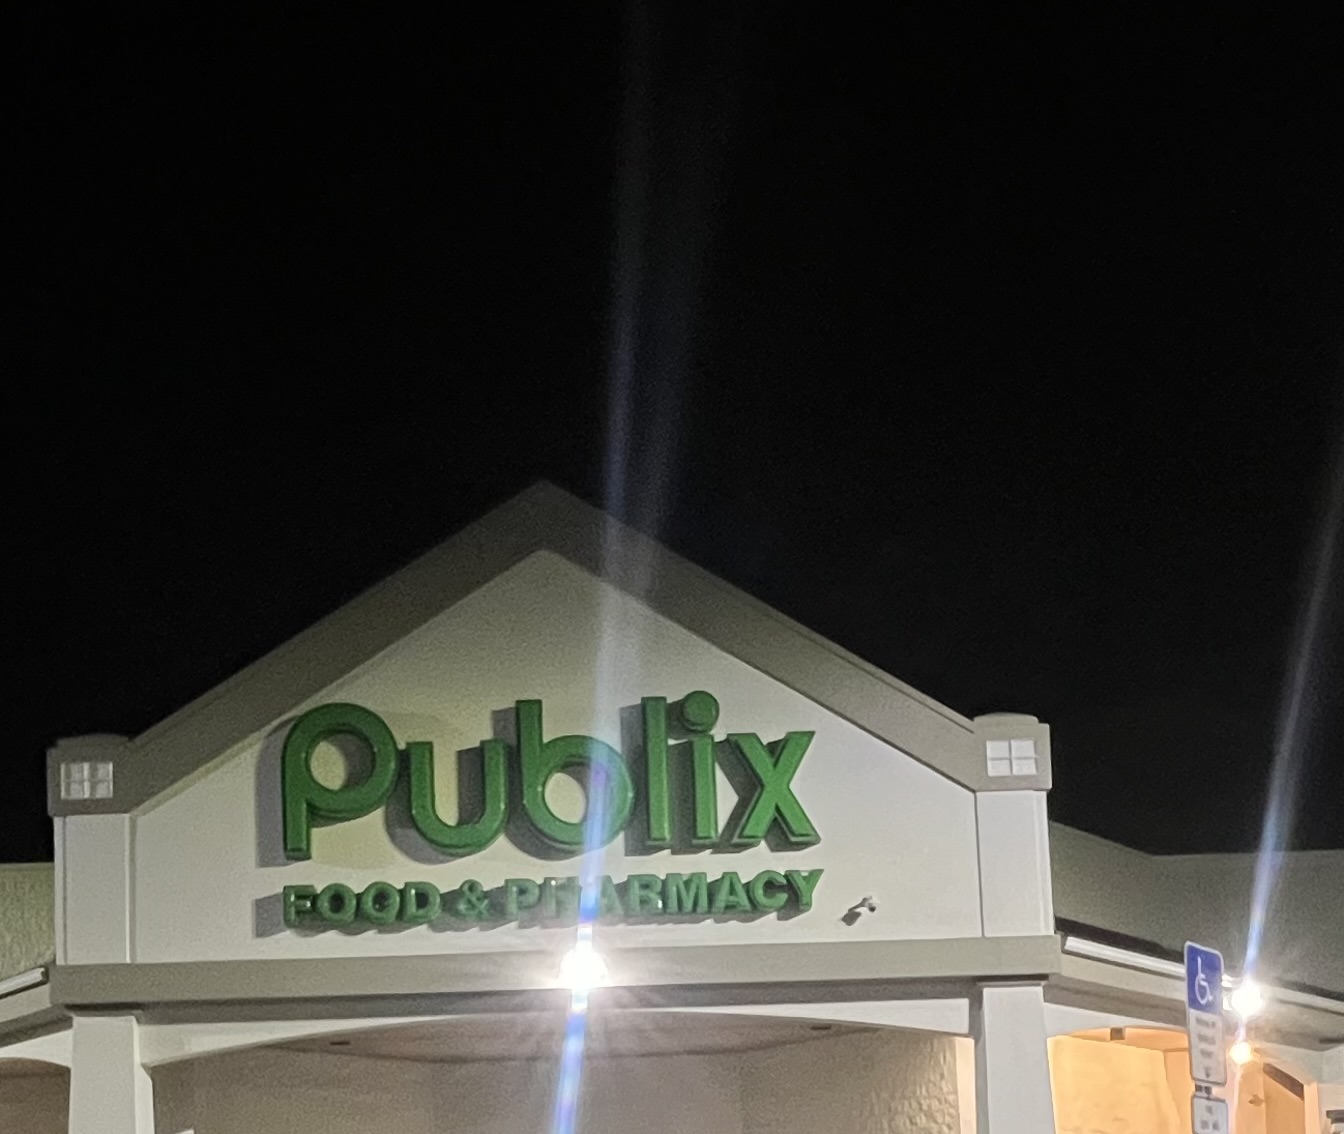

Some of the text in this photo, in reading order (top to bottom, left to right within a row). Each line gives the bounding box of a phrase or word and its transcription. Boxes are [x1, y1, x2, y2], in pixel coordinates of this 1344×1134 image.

[281, 690, 821, 860] Publix
[282, 869, 824, 926] FOOD & PHARMACY
